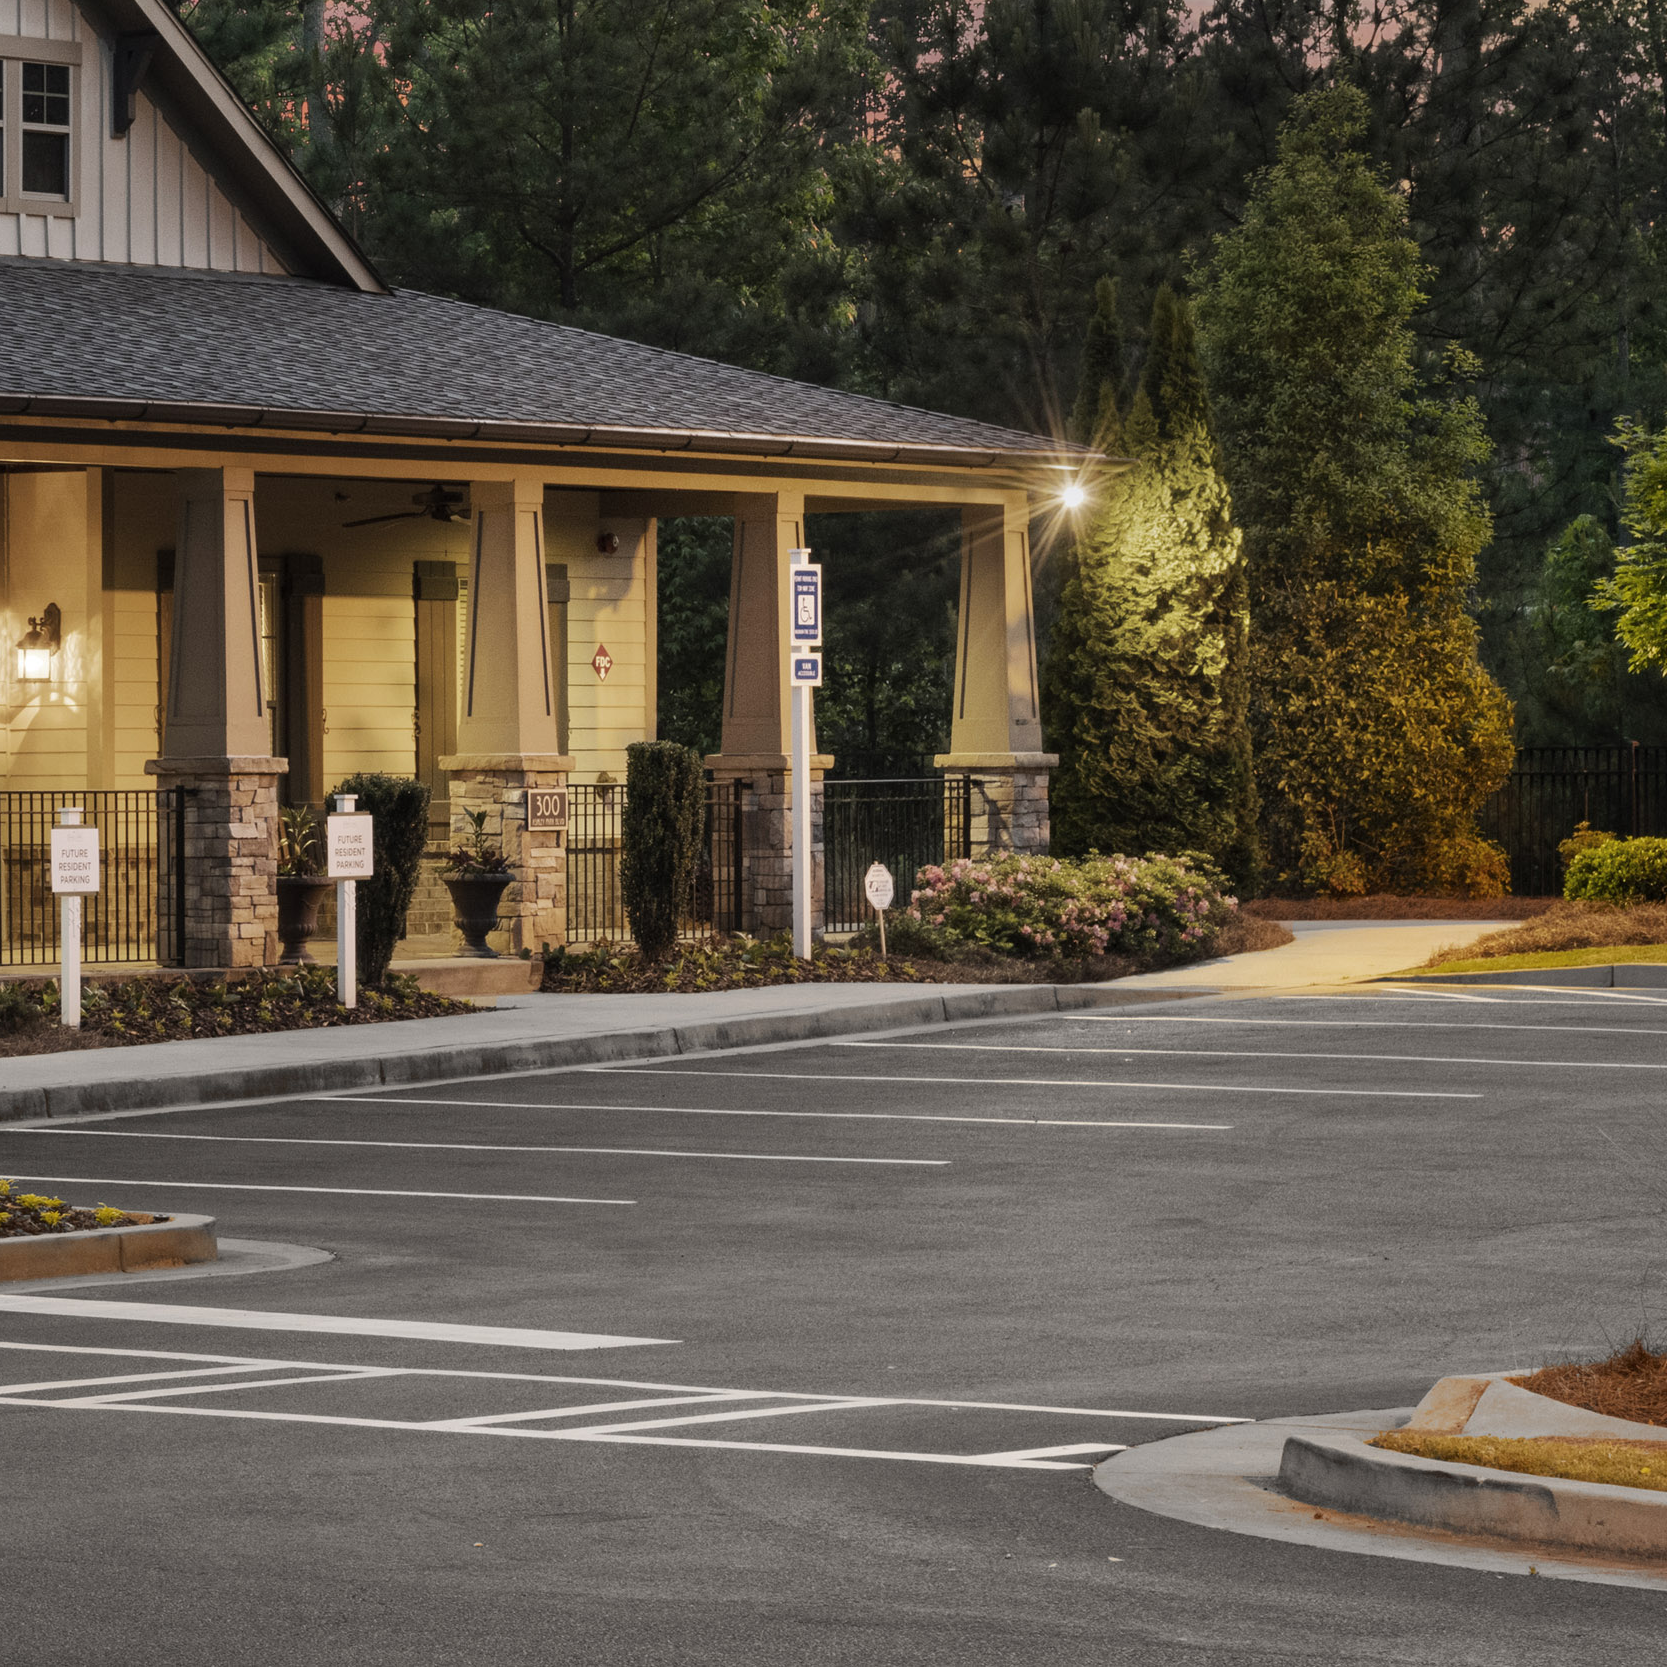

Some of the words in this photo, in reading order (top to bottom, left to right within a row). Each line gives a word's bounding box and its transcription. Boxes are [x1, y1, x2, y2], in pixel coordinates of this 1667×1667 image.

[595, 656, 611, 667] FDC
[802, 662, 811, 670] VAN
[537, 795, 559, 816] 300
[337, 835, 363, 844] FUTURE
[61, 849, 88, 858] FUTURE
[335, 847, 365, 856] RESIDENT
[59, 862, 91, 871] RESIDENT
[337, 860, 364, 869] PARKING
[60, 876, 90, 884] PARKING
